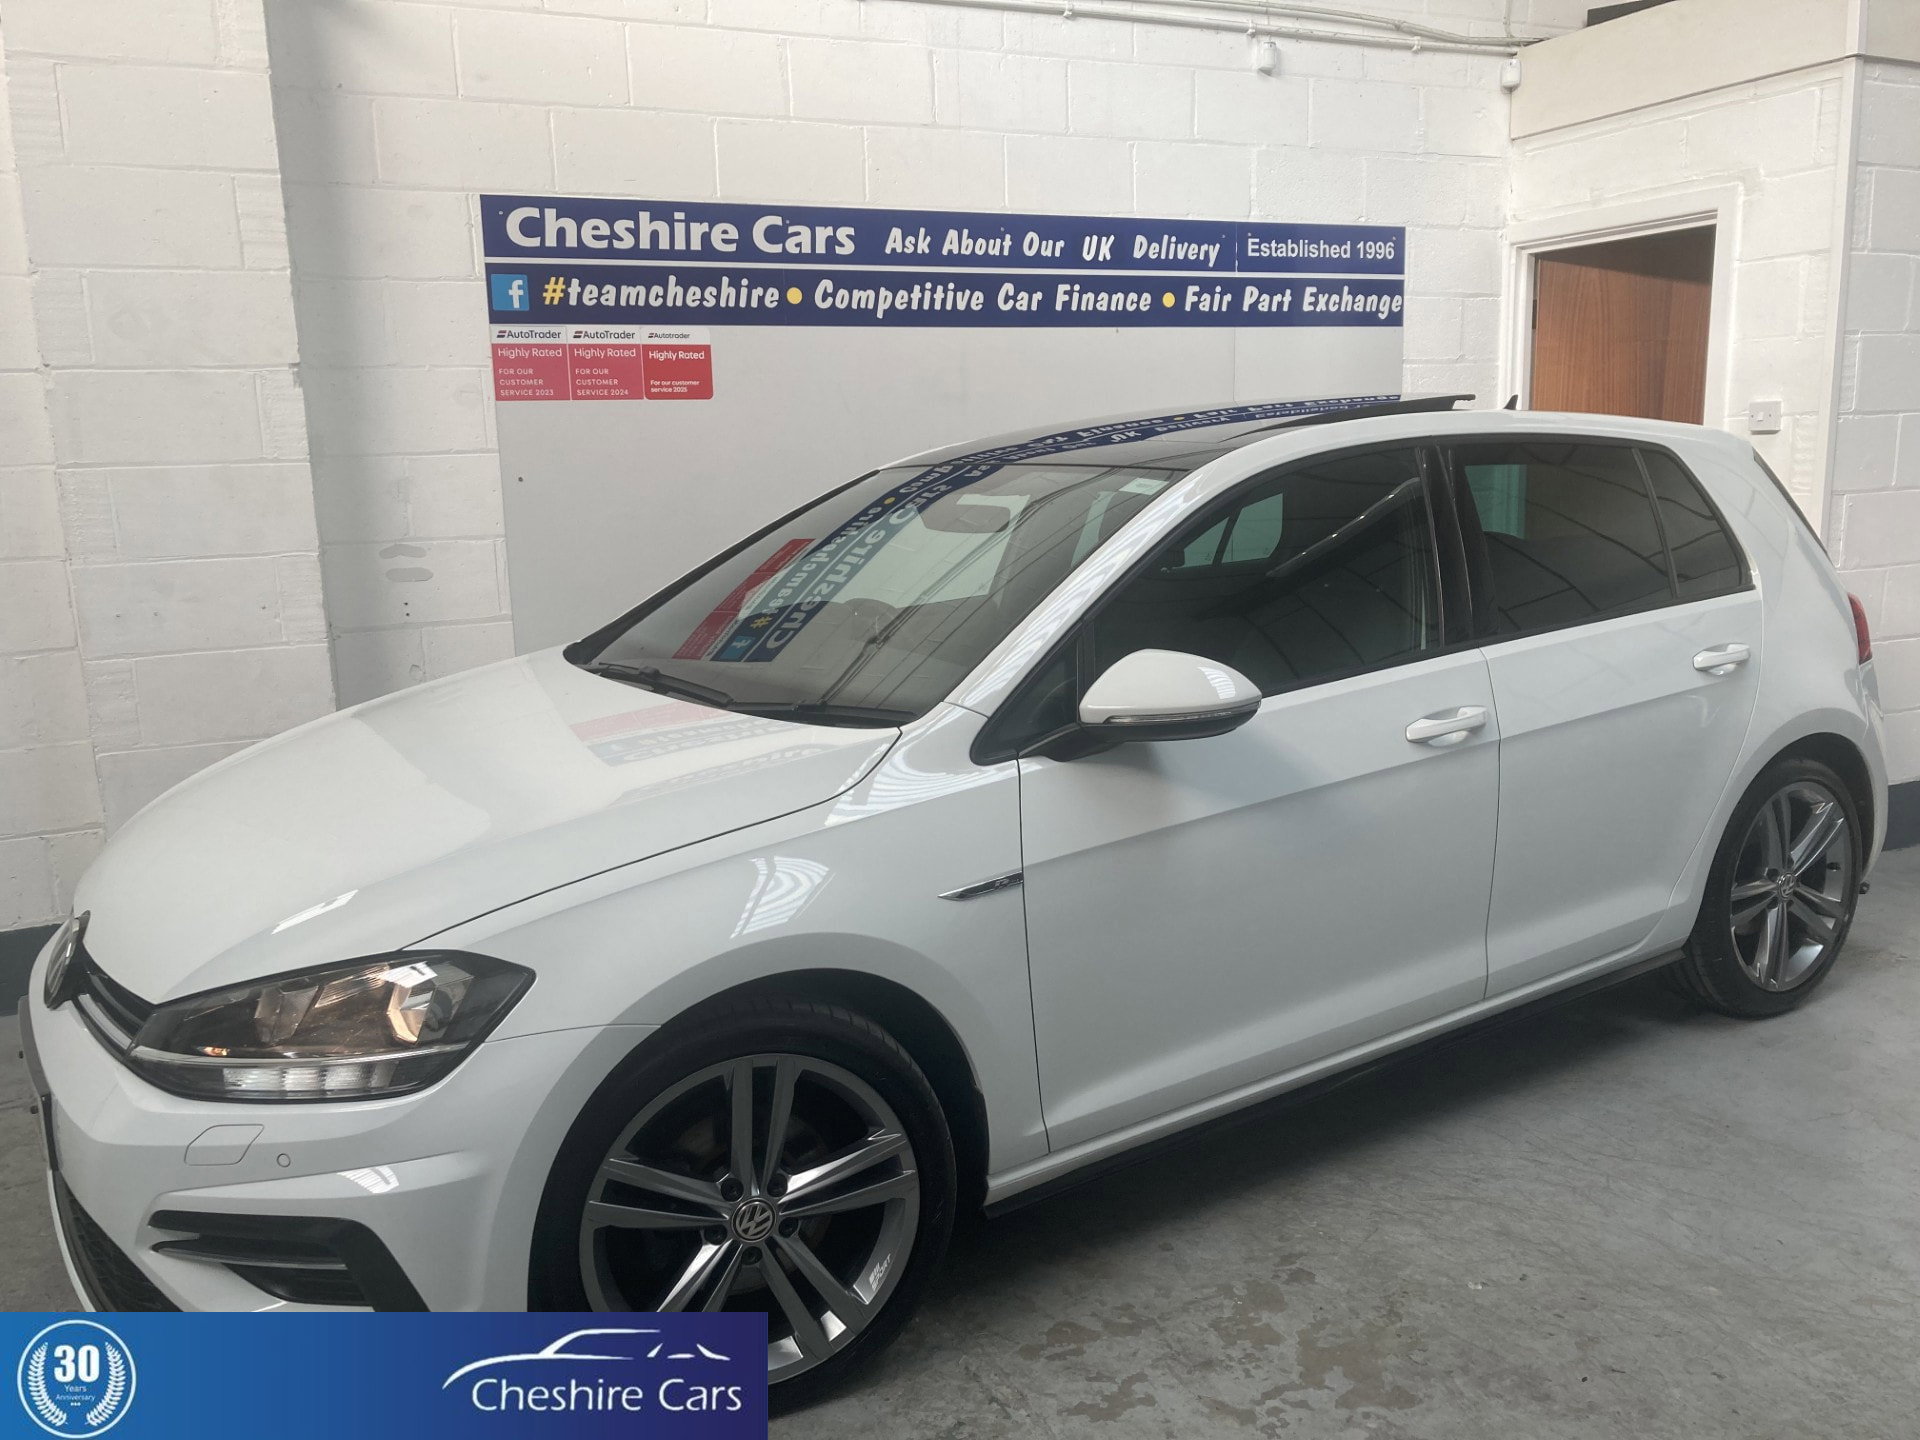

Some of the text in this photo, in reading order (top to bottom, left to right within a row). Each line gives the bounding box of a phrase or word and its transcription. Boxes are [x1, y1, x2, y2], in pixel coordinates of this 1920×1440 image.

[506, 206, 856, 255] Cheshire Cars
[884, 226, 1221, 268] Ask About Our UK Delivery
[1247, 238, 1395, 260] Established 1996
[542, 274, 780, 308] #teamcheshire
[814, 279, 1152, 319] Competitive Car Finance
[1184, 285, 1402, 320] Fair Part Exchange
[507, 330, 562, 340] AutoTrader
[583, 330, 636, 340] AutoTrader
[498, 348, 562, 360] Highly Rated
[574, 348, 636, 360] Highly Rated
[649, 351, 705, 362] Highly Rated
